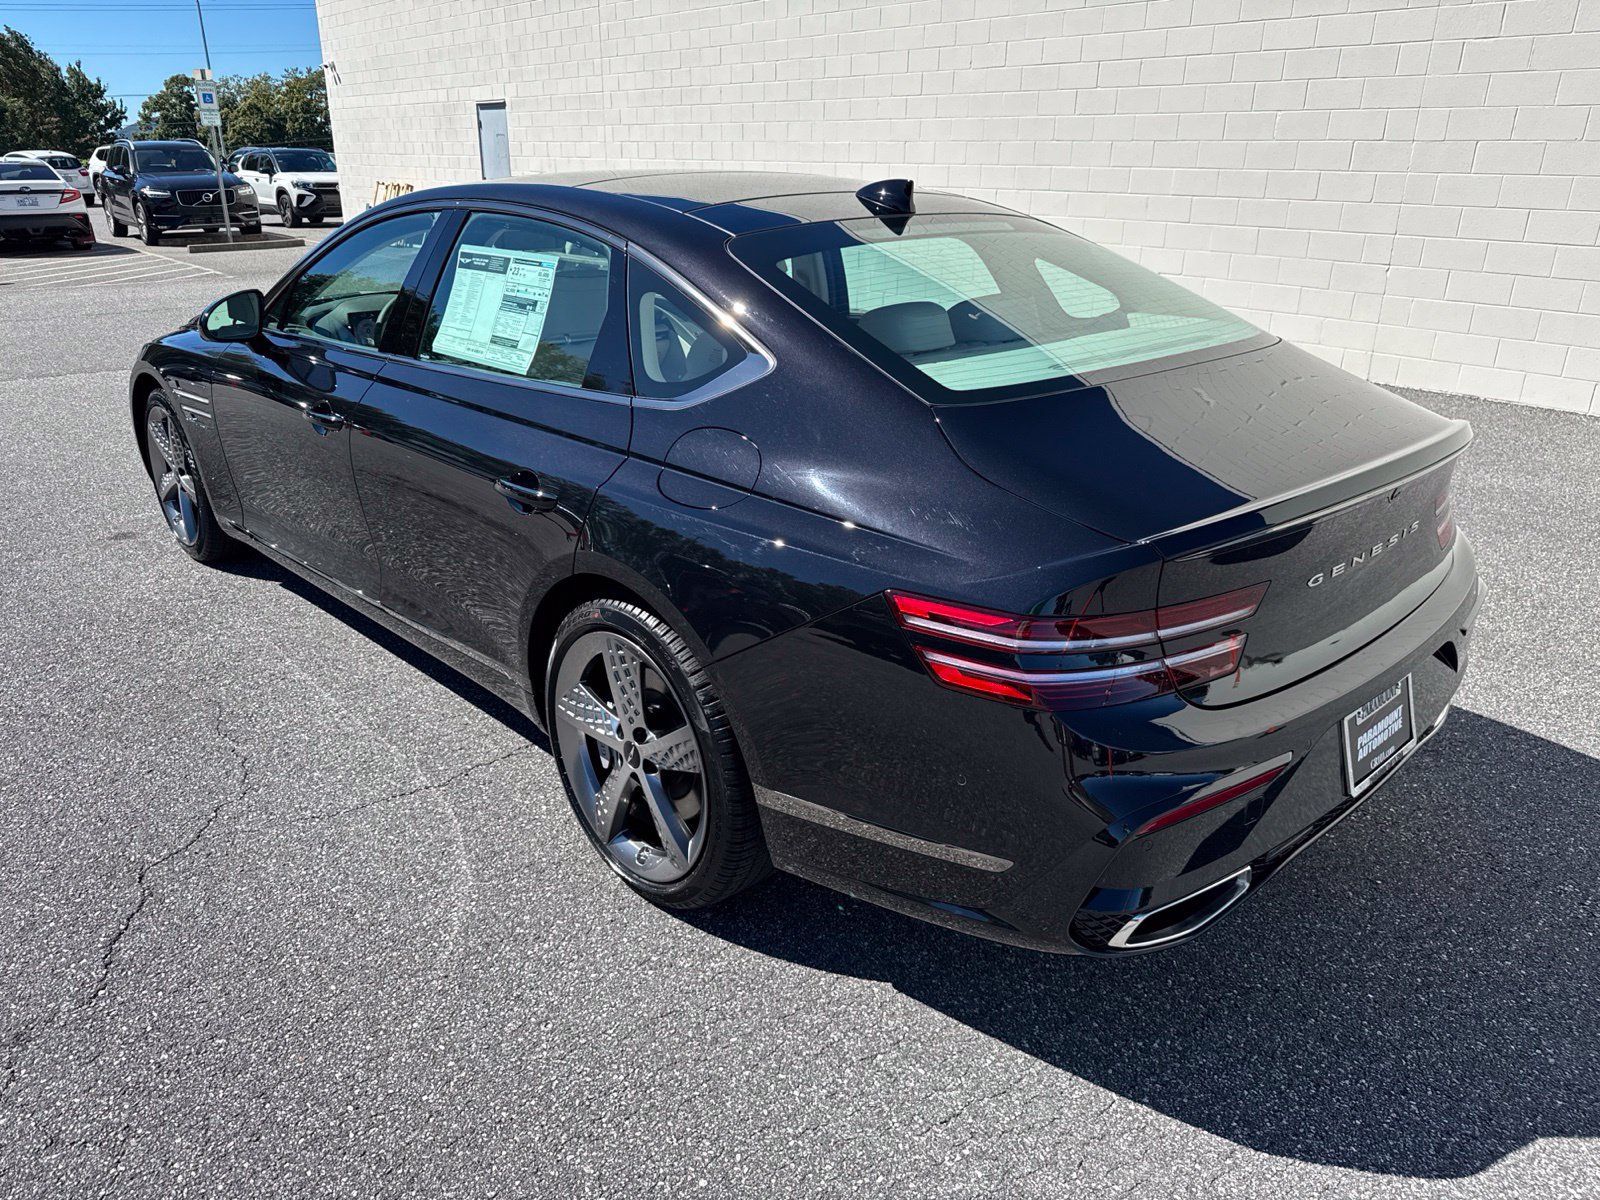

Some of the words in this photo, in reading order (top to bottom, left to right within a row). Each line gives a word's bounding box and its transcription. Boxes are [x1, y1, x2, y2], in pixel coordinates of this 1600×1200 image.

[1307, 520, 1420, 588] GENESIS
[1357, 704, 1404, 750] PARAMOUNT
[1357, 716, 1403, 762] AUTOMOTIVE
